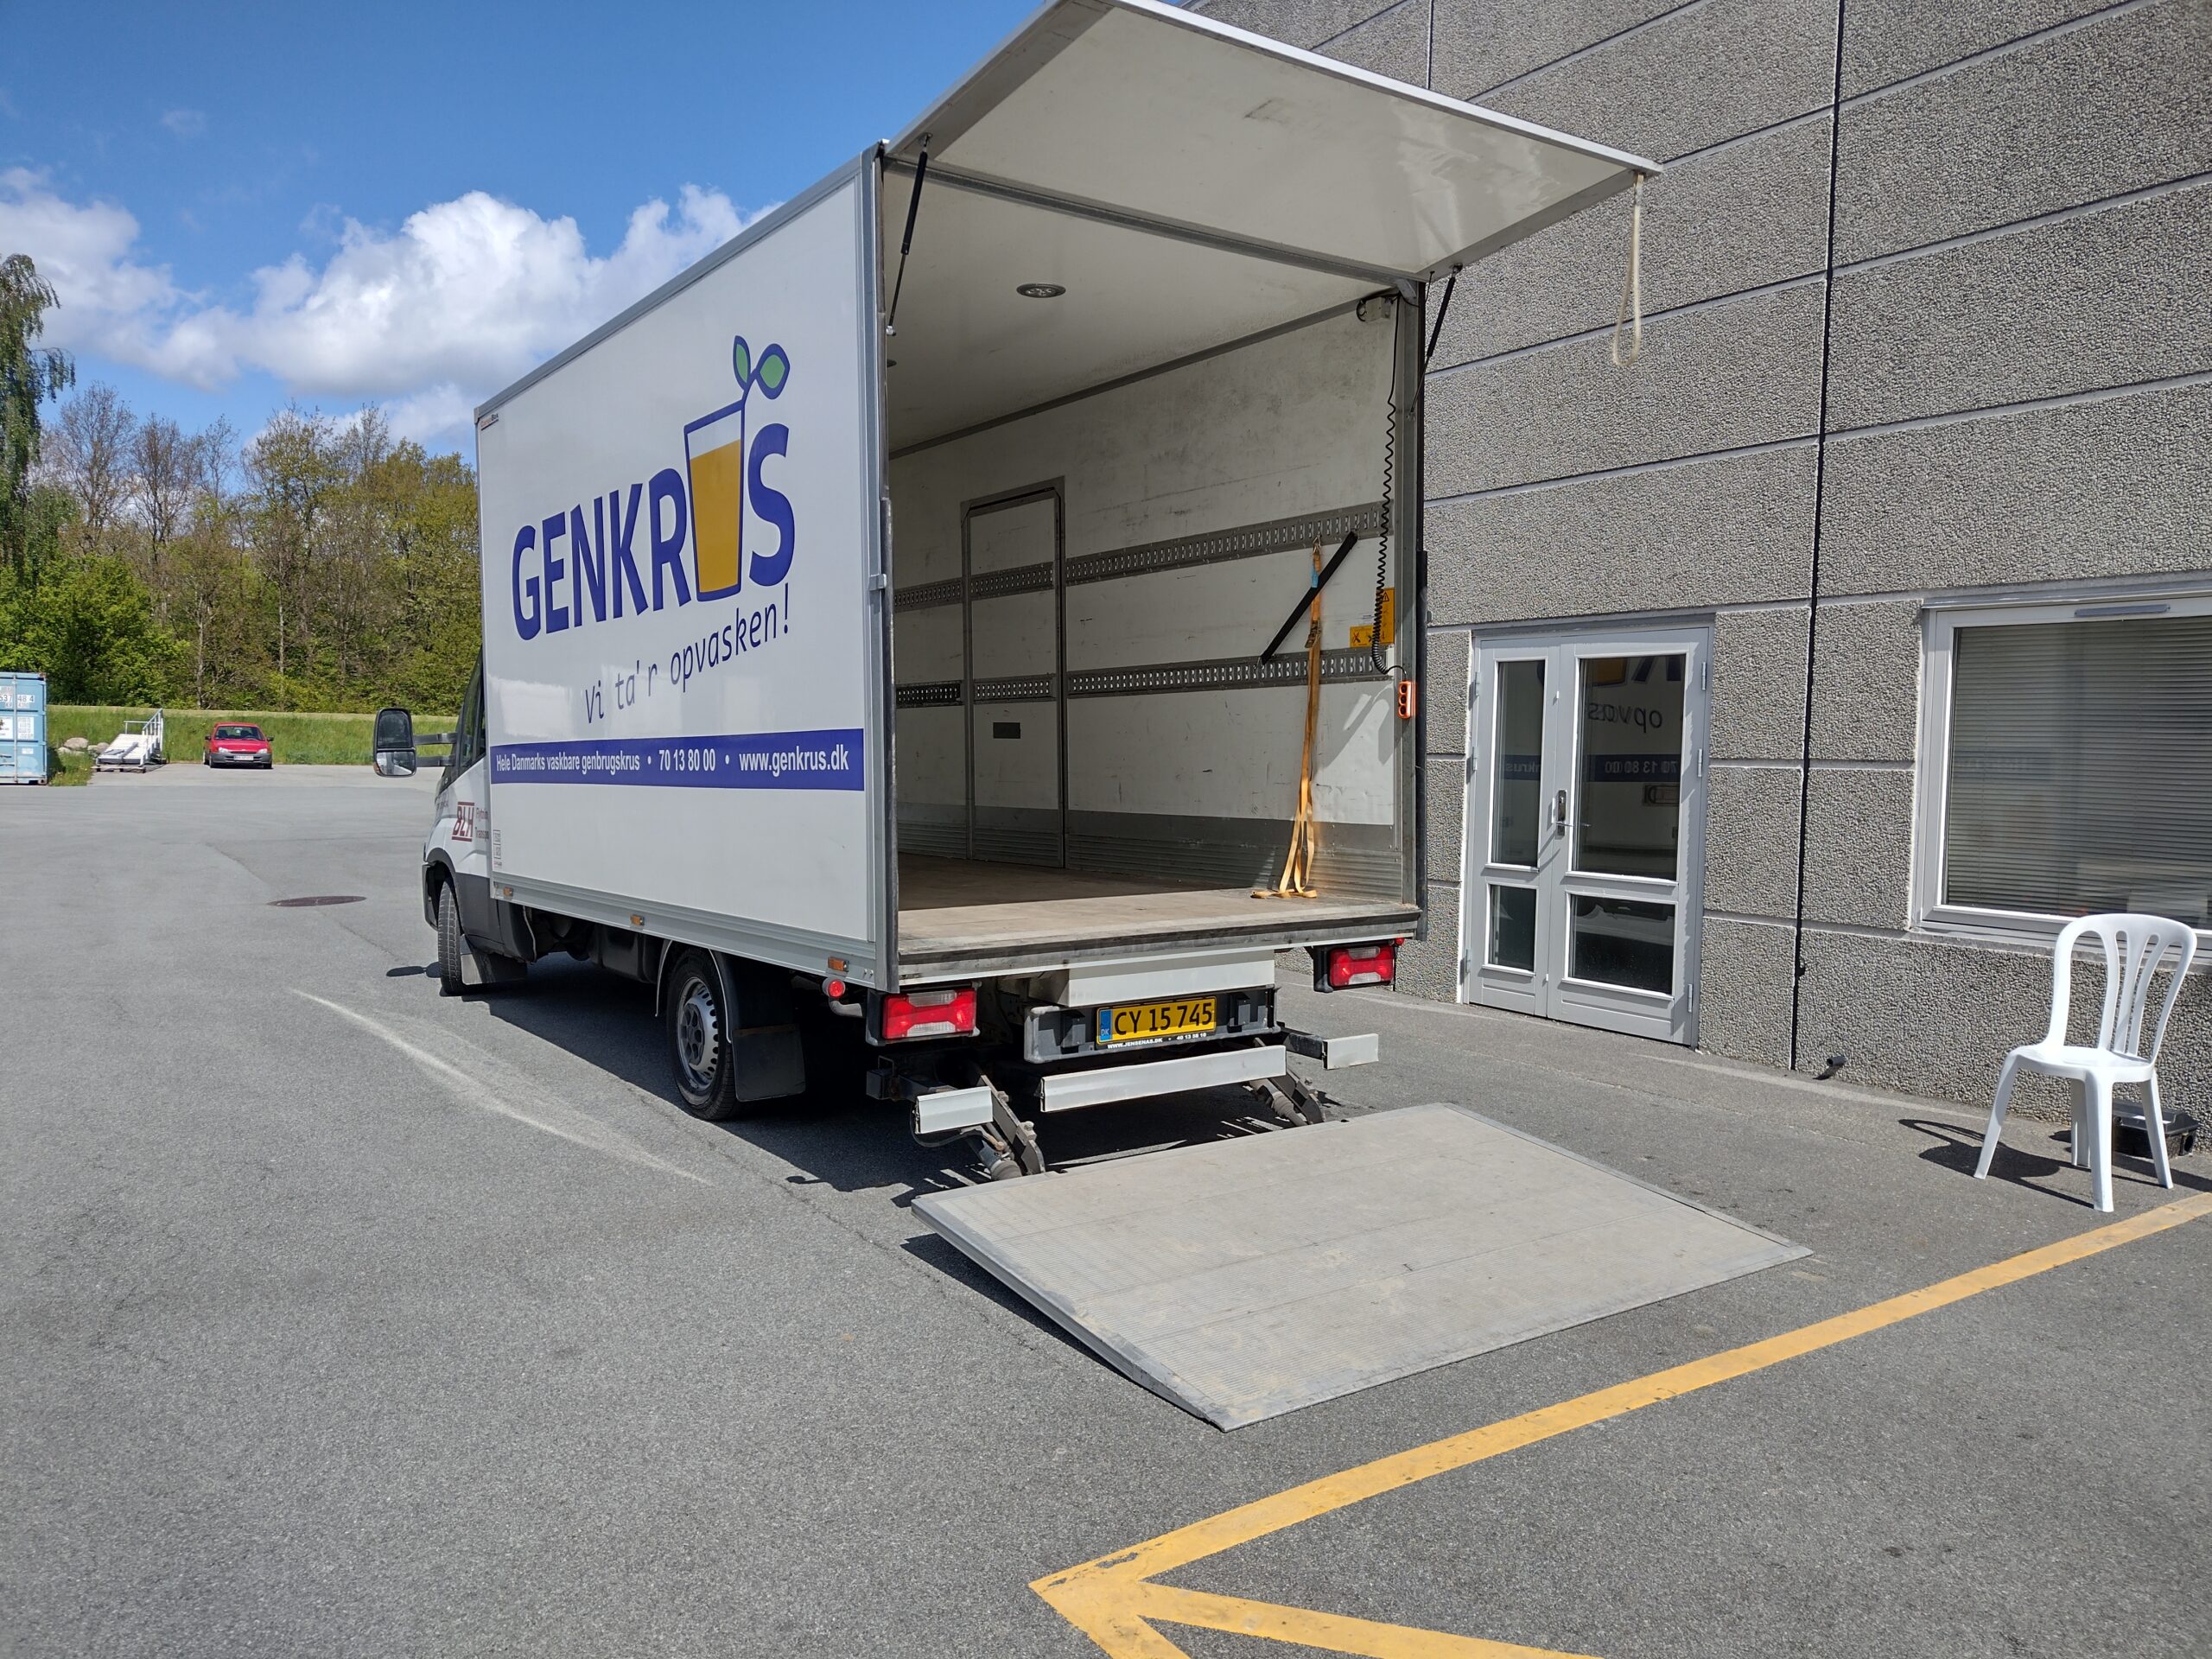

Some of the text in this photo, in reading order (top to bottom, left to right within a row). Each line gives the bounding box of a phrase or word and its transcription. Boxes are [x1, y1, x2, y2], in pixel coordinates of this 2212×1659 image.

[671, 582, 789, 693] opvasken!
[496, 744, 849, 778] Hele Danmarks vaskbare genbrugskrus 70 13 80 00 www.genkrus.dk
[452, 805, 475, 838] BLH
[1101, 1027, 1109, 1036] DK
[1114, 1002, 1212, 1035] CY 15 745
